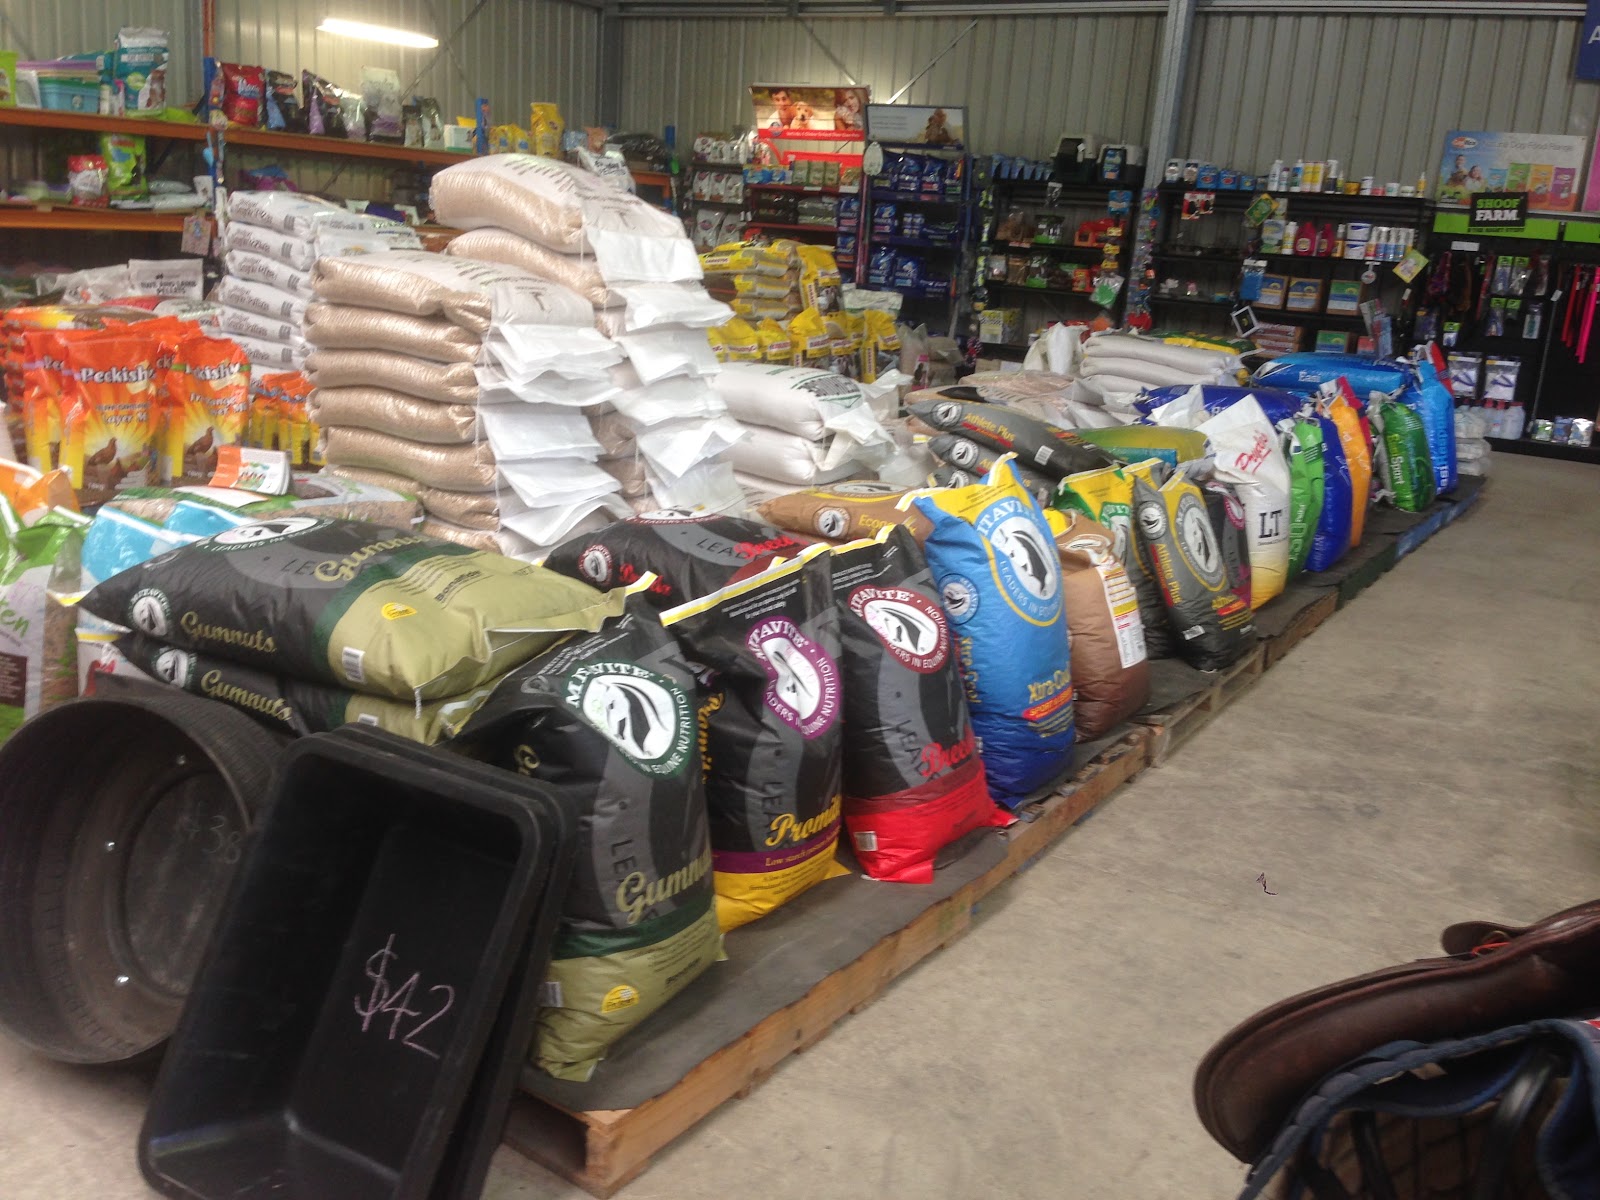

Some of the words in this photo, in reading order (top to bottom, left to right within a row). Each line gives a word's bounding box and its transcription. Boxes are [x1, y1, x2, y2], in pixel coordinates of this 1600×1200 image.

[1474, 209, 1519, 221] FARM
[1476, 198, 1520, 209] SHOOF
[964, 412, 997, 431] Athlete
[997, 424, 1016, 442] Plus
[1258, 509, 1283, 539] LT
[1167, 581, 1183, 604] Plus
[180, 611, 277, 653] Gumnuts
[201, 668, 294, 722] Gumnuts
[816, 656, 837, 718] NUTRITION
[671, 687, 692, 754] NUTRITION
[354, 933, 456, 1060] $42
